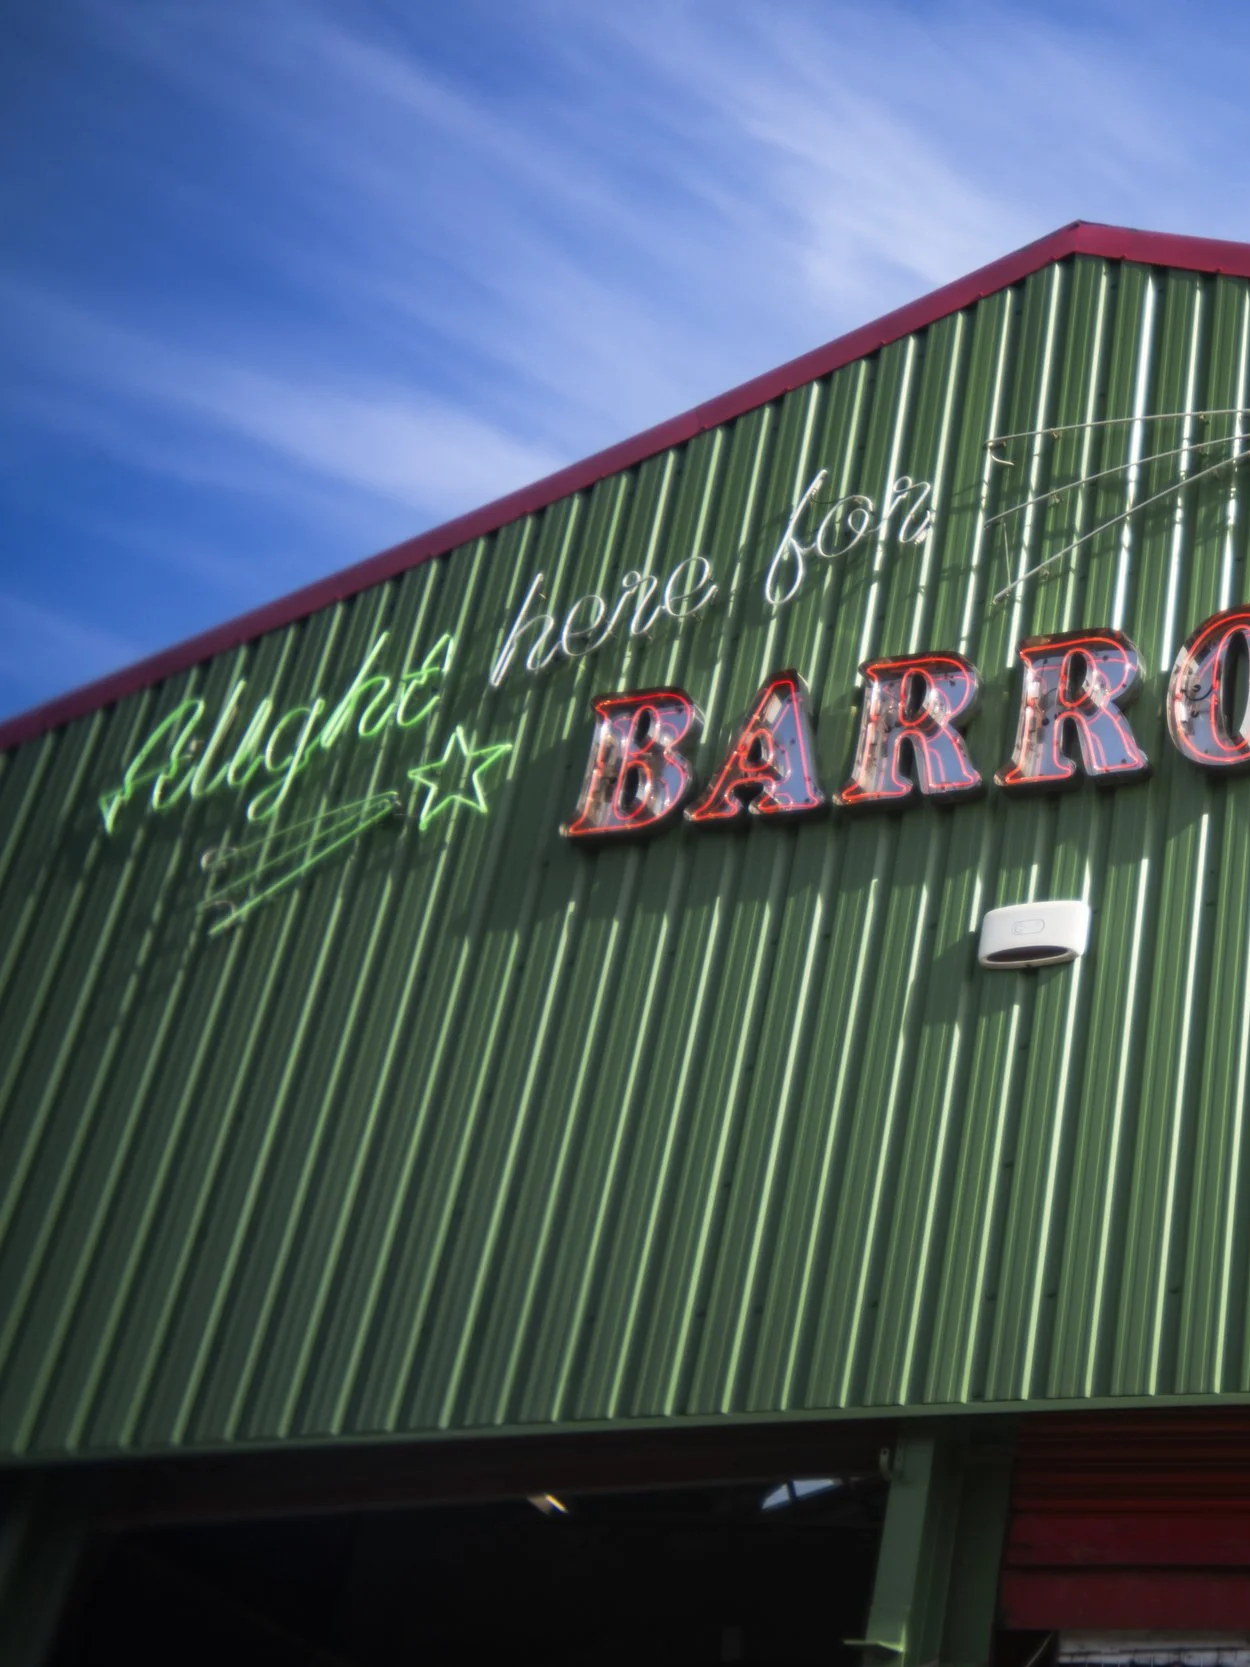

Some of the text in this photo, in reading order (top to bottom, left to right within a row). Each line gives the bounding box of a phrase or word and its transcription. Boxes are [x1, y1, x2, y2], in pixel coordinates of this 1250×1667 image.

[98, 468, 937, 835] Alight here for
